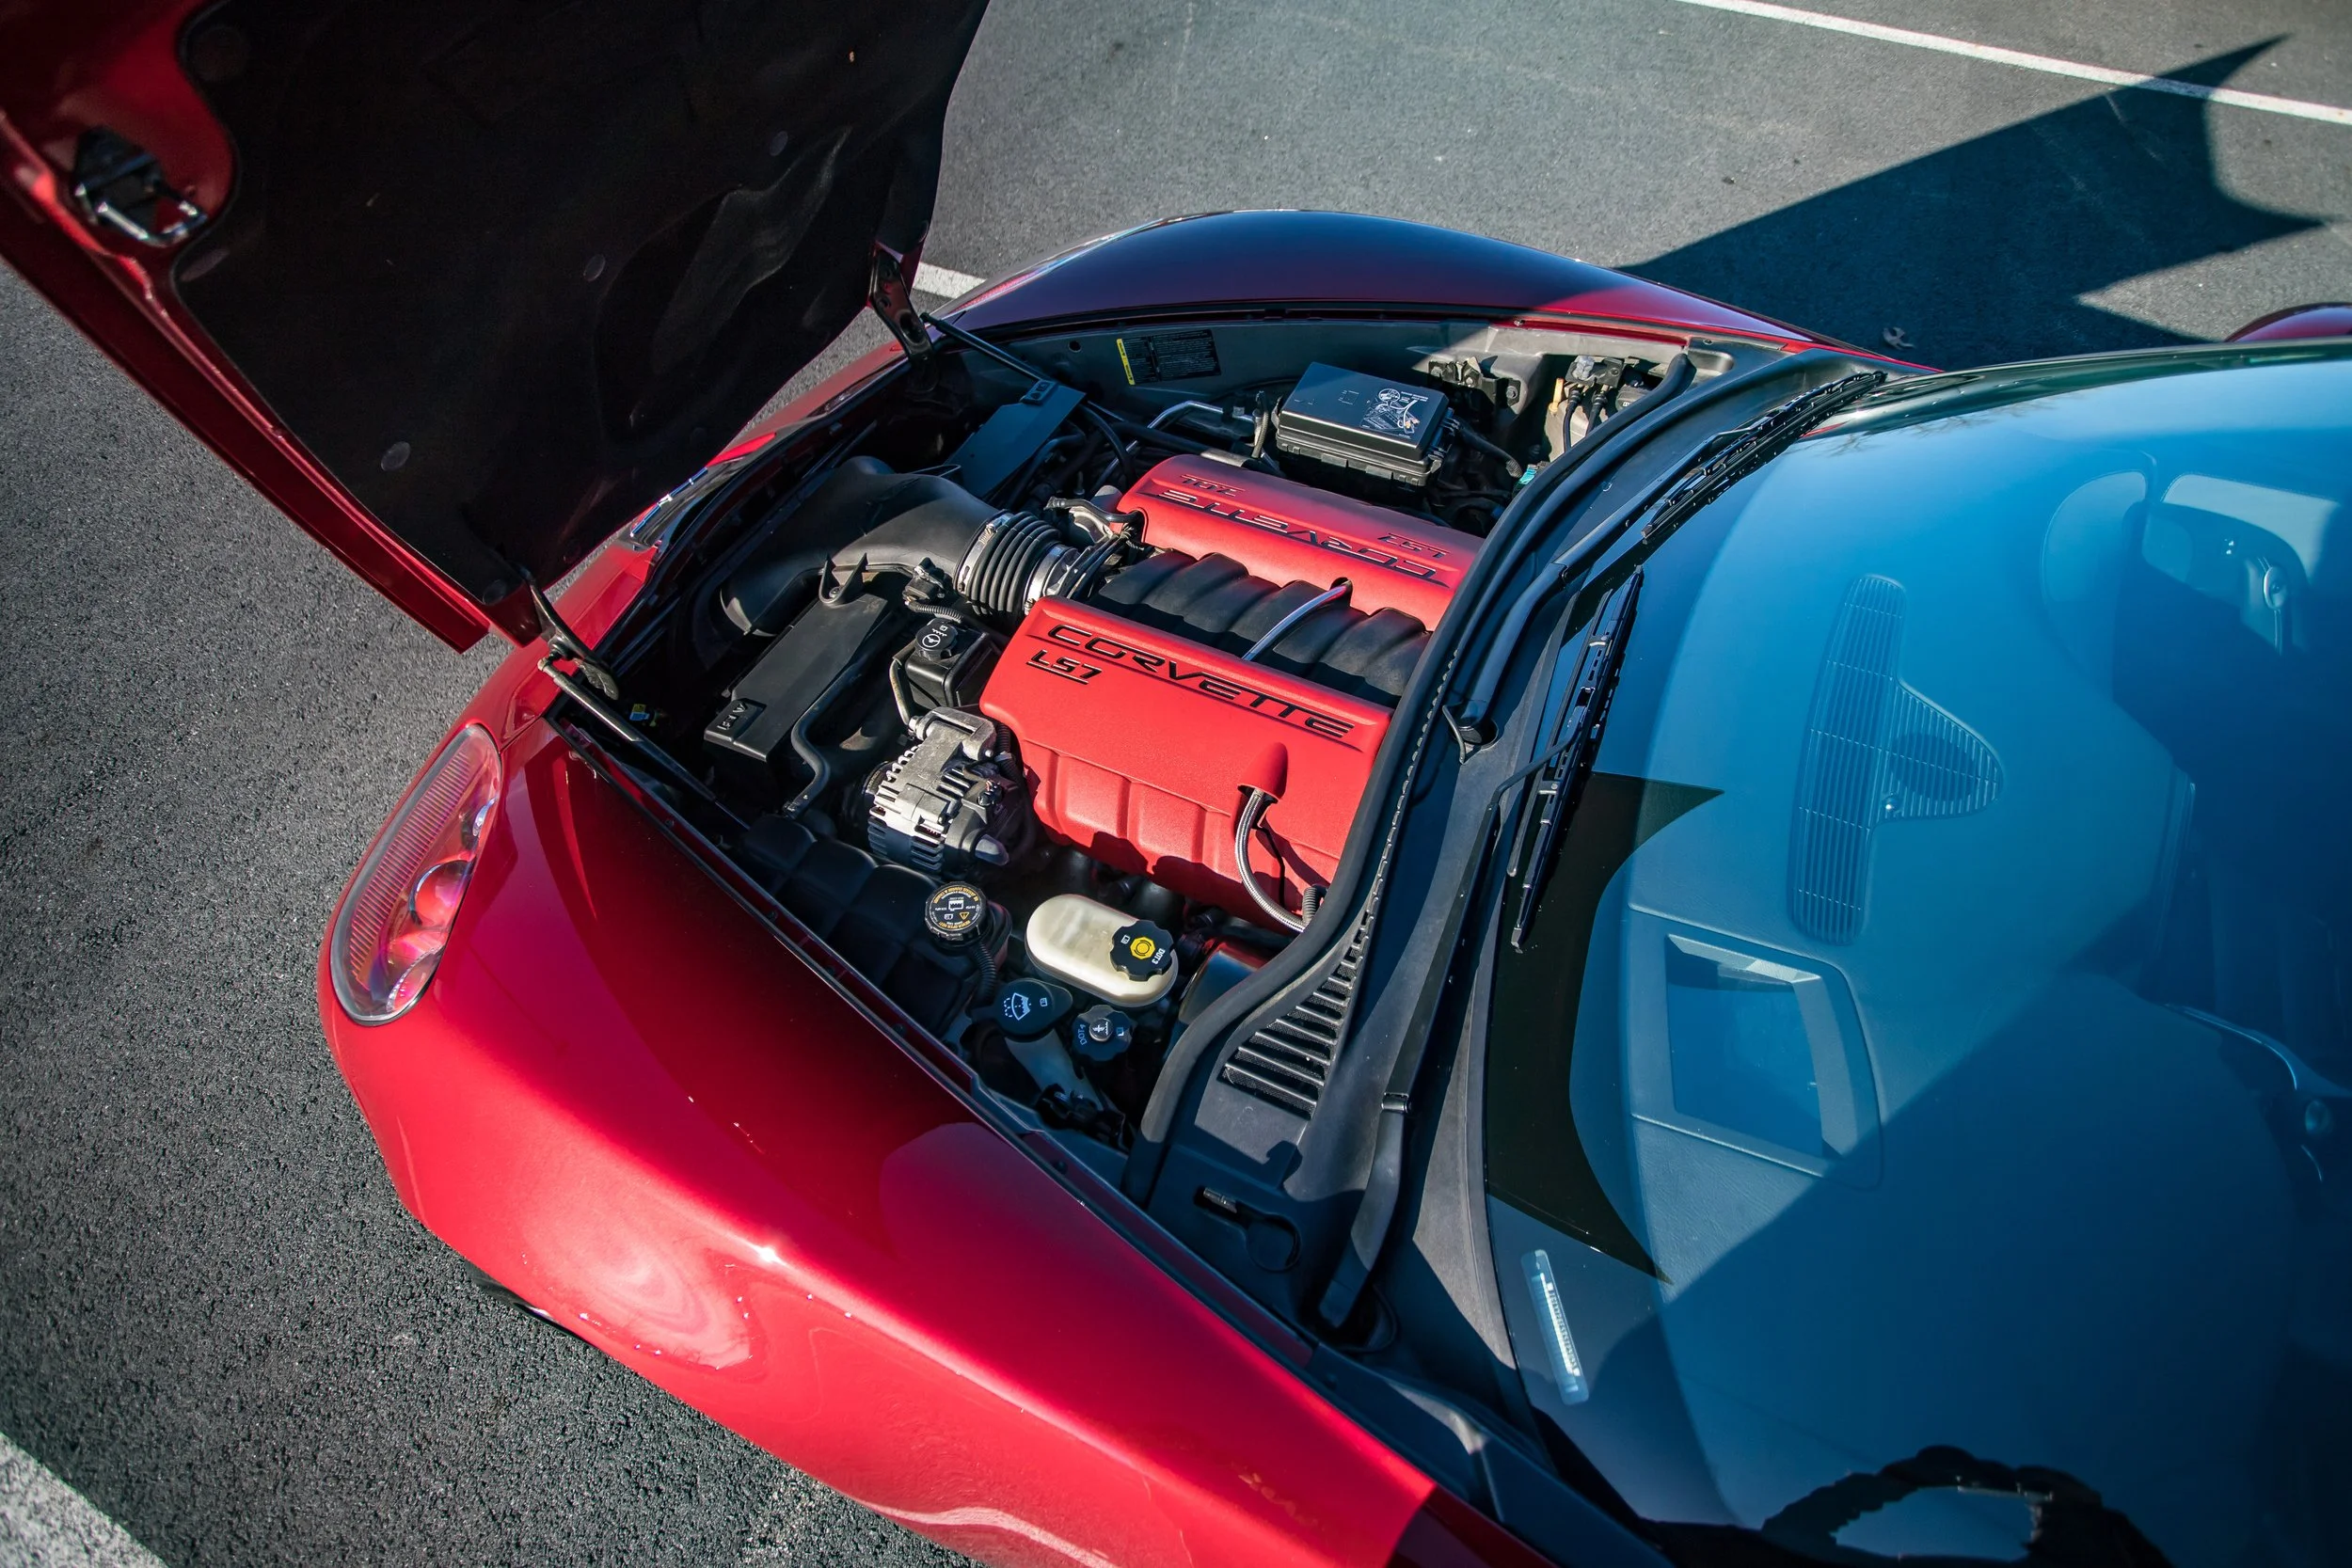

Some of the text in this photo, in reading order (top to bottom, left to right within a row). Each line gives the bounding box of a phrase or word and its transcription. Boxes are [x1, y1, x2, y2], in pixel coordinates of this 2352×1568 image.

[1158, 489, 1437, 579] CORVETTE
[1377, 533, 1447, 559] LS7
[1030, 649, 1103, 680] LS7
[1047, 624, 1355, 738] CORVETTE
